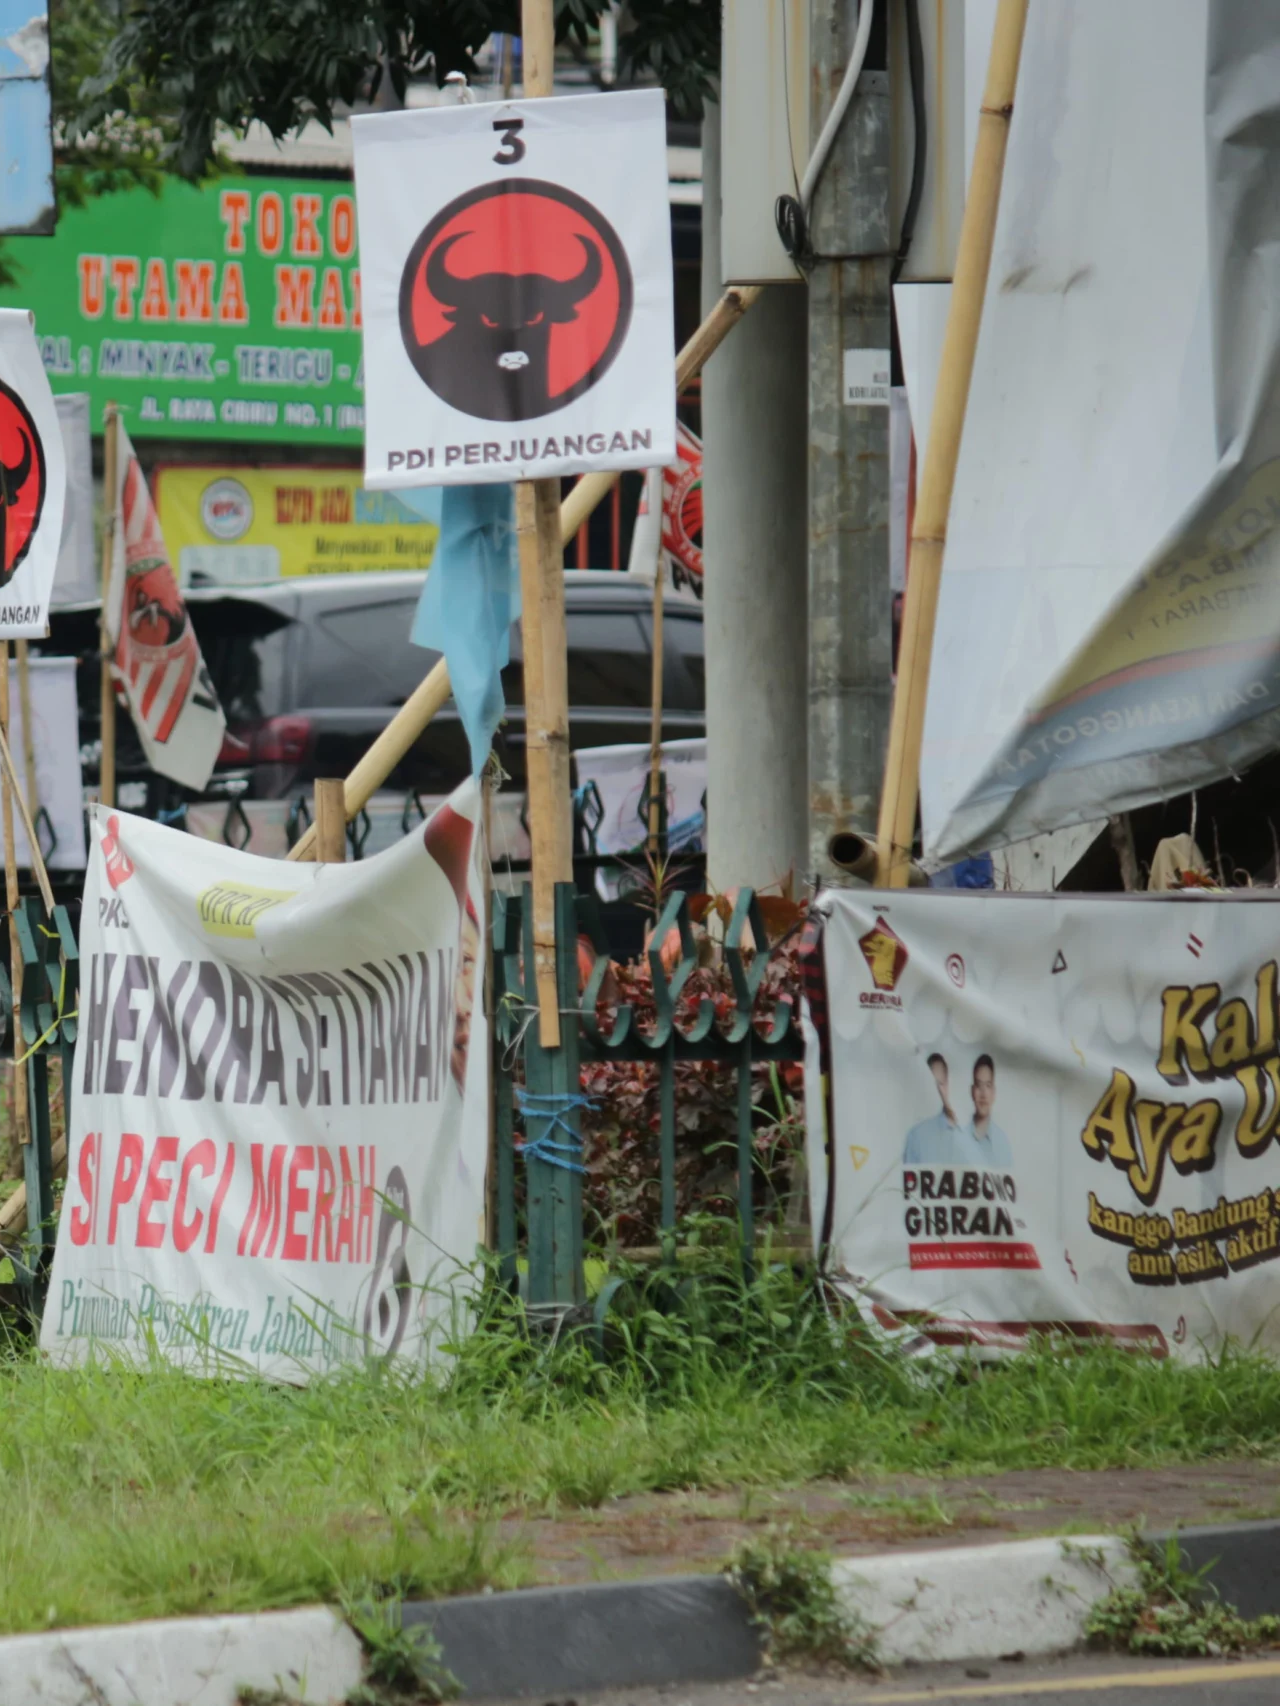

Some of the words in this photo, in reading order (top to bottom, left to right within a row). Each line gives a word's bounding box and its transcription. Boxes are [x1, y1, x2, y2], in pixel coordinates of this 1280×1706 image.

[491, 118, 526, 165] 3
[221, 190, 357, 258] TOKO
[78, 254, 249, 326] UTAMA
[97, 340, 215, 381] MINYAK
[235, 344, 333, 385] TERIGU
[387, 447, 434, 472] PDI
[444, 428, 653, 467] PERJUANGAN
[1080, 1066, 1223, 1206] Aya
[69, 1132, 103, 1247] SI
[106, 1133, 236, 1254] PECI
[236, 1143, 377, 1264] MERAH
[903, 1169, 1017, 1203] PRABOWO
[904, 1205, 1015, 1237] GIBRAN
[1087, 1191, 1172, 1251] kanggo
[1171, 1187, 1271, 1245] Bandung
[1127, 1250, 1175, 1285] anu
